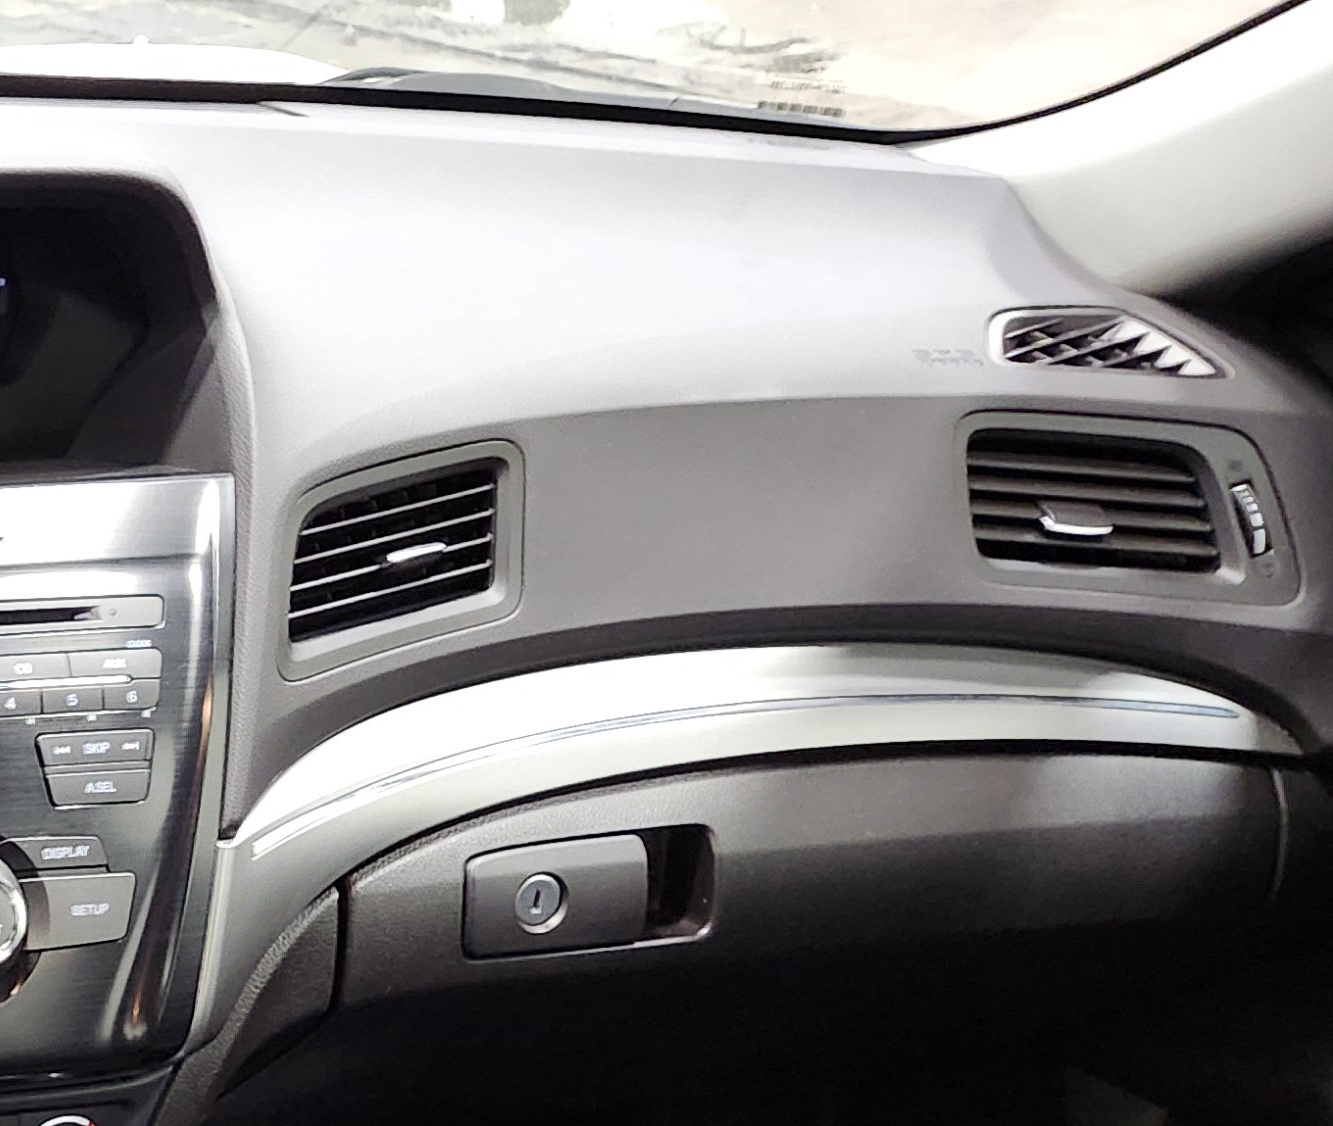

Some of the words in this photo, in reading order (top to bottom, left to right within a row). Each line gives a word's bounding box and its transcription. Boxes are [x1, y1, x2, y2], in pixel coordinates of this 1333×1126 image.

[4, 696, 16, 711] 4
[66, 693, 79, 707] 5
[125, 690, 138, 704] 6
[41, 844, 91, 861] DISPLAY
[69, 902, 111, 917] SETUP
